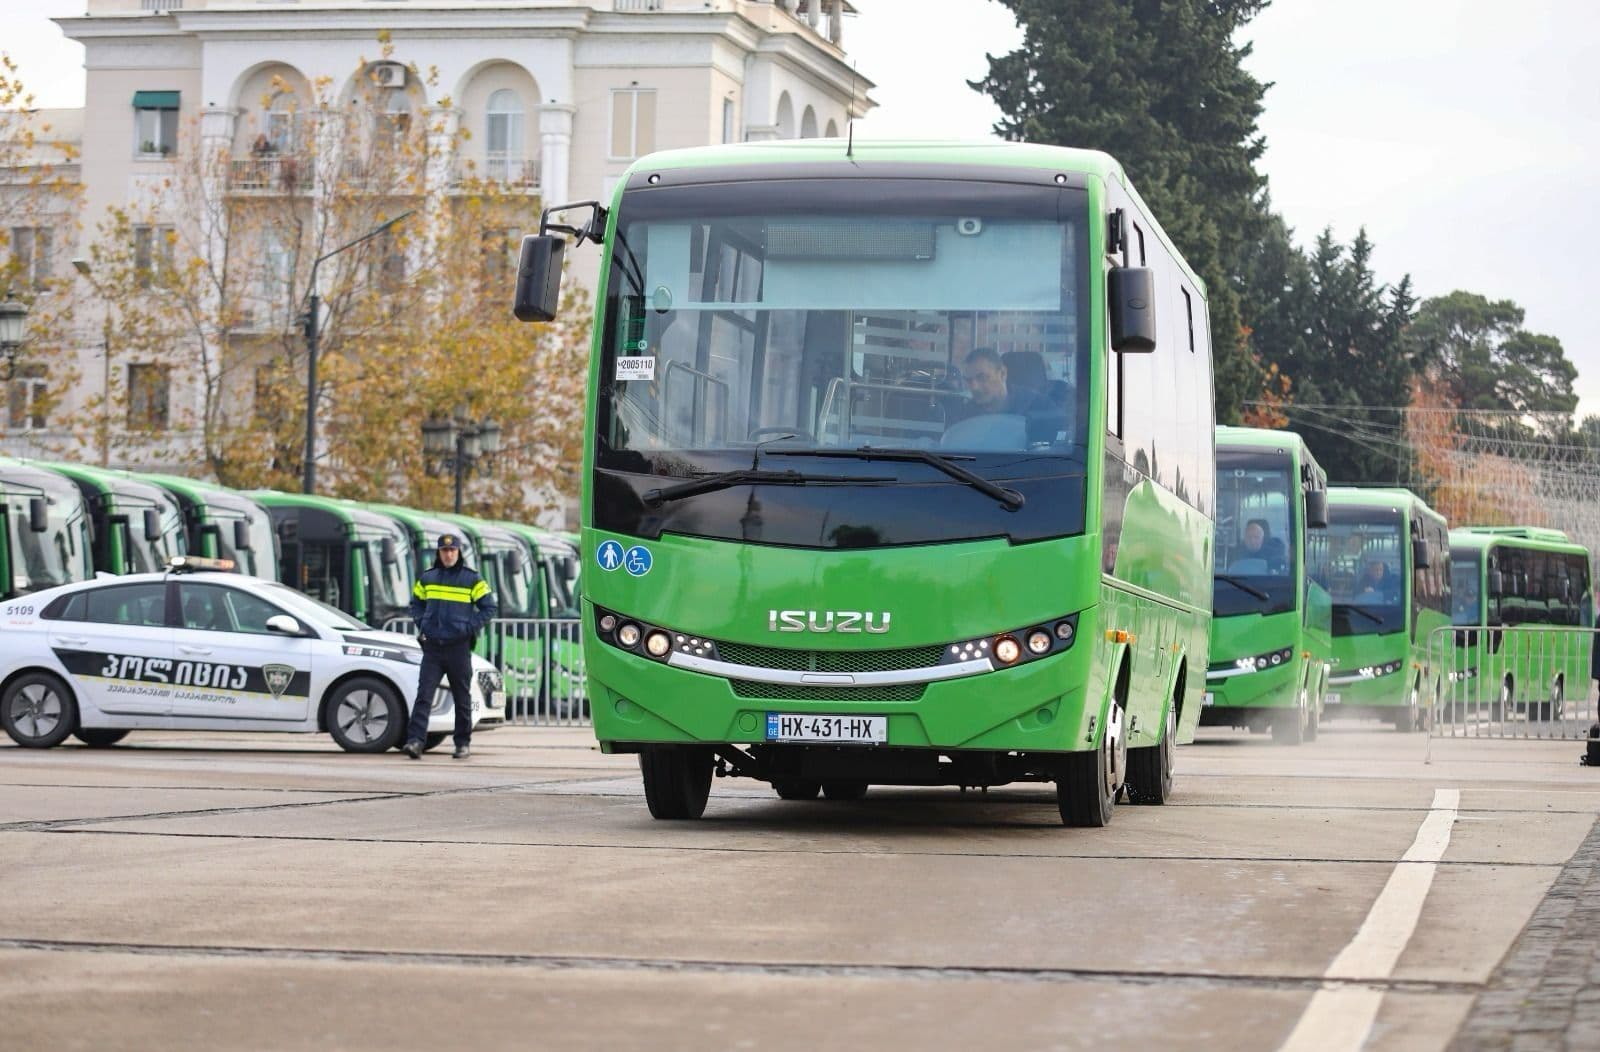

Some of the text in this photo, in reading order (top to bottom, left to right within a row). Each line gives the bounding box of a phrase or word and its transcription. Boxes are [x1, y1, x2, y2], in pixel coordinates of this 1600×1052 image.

[7, 605, 34, 616] 5109
[768, 609, 891, 634] ISUZU
[370, 648, 385, 658] 112
[102, 654, 249, 690] პოლიცია
[768, 717, 873, 739] GE HX-431-HX
